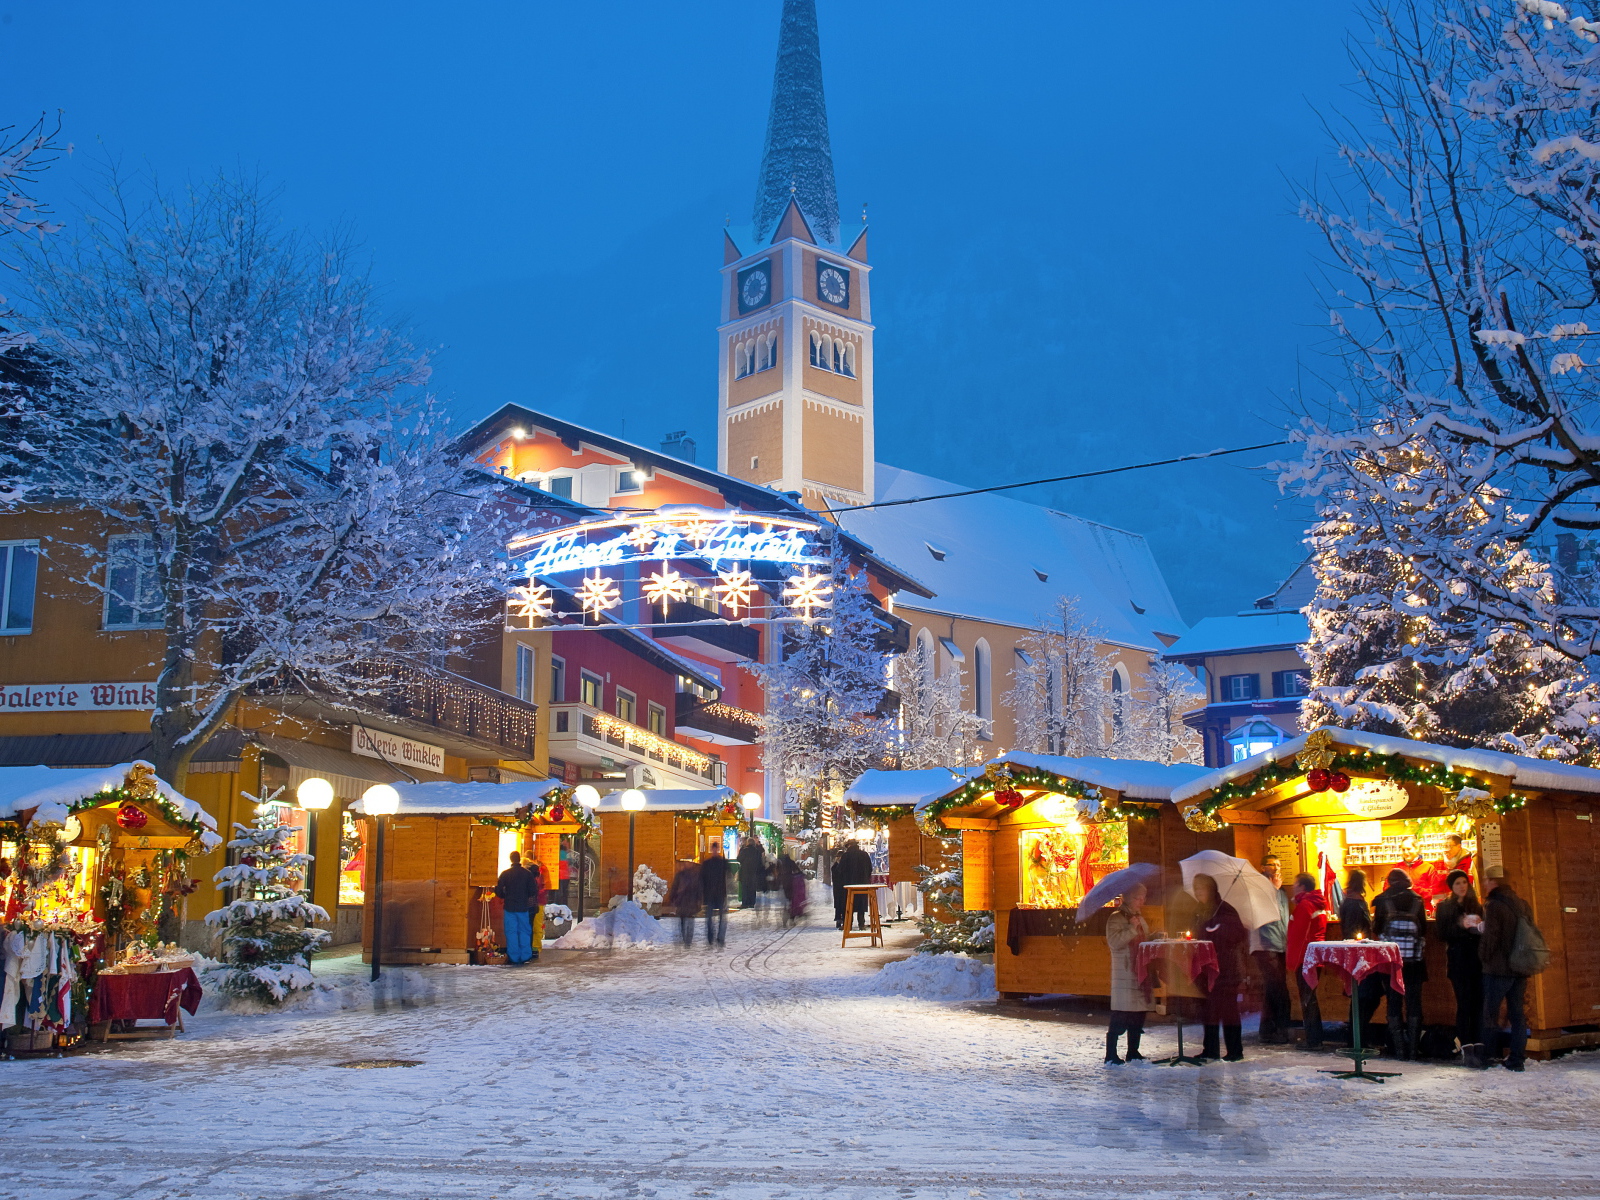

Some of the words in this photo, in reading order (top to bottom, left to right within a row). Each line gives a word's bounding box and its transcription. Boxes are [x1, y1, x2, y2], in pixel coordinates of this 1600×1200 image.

[90, 684, 157, 706] Wink
[357, 728, 398, 757] Galerie
[402, 741, 441, 767] Winkler
